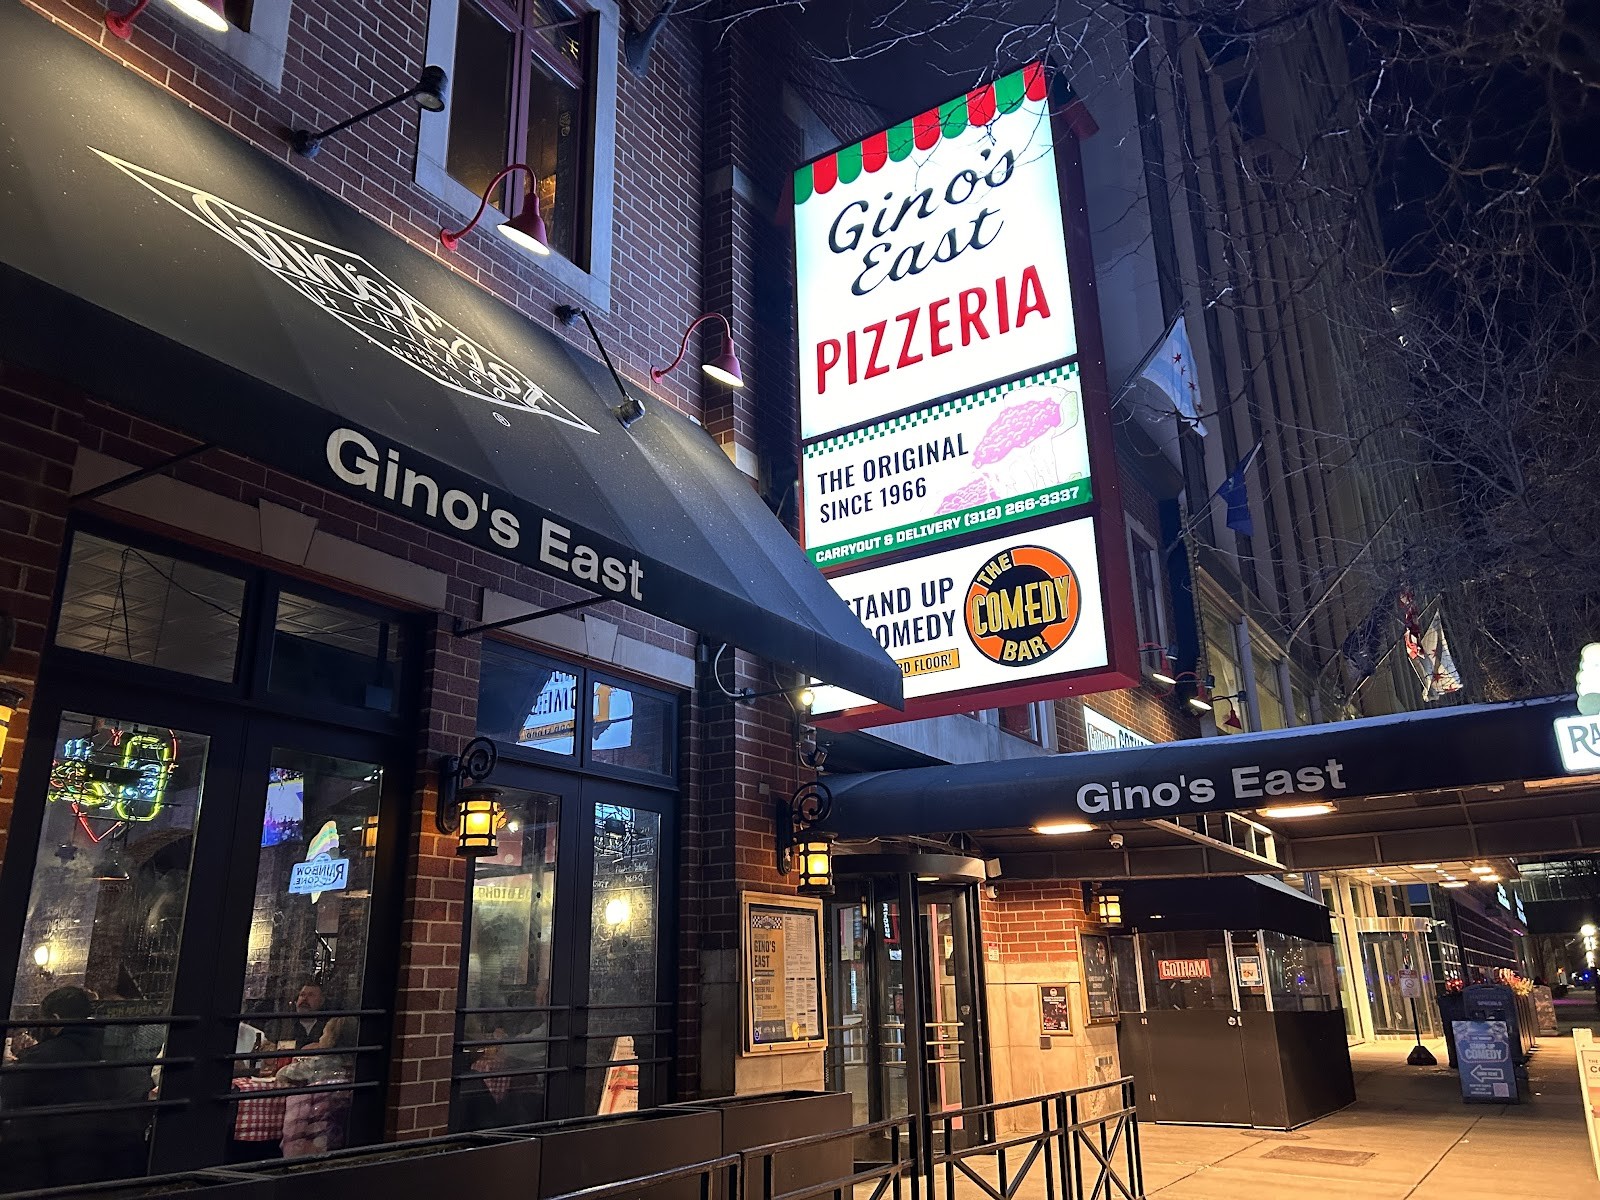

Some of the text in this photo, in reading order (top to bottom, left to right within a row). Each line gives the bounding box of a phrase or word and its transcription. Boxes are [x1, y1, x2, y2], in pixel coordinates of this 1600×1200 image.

[828, 149, 1014, 254] Gino's
[851, 208, 1004, 296] East
[193, 193, 550, 412] GINO'S EAST
[353, 301, 506, 400] CHICAGO
[816, 265, 1051, 394] PIZZERIA
[818, 432, 969, 495] THE ORIGINAL
[326, 427, 645, 601] Gino's East
[815, 486, 1080, 563] CARRYOUT & DELIVERY (312) 266-3337
[820, 477, 928, 524] SINCE 1966
[976, 552, 1014, 586] THE
[844, 577, 954, 620] TAND UP
[971, 574, 1071, 637] COMEDY
[867, 609, 956, 650] OMEDY
[1003, 636, 1048, 662] BAR
[914, 653, 952, 672] FLOOR!
[1076, 759, 1347, 814] Gino's East
[754, 940, 776, 953] GINO'S
[754, 954, 770, 968] EAST
[1162, 960, 1207, 978] GOTHAM
[1464, 1049, 1502, 1060] COMEDY
